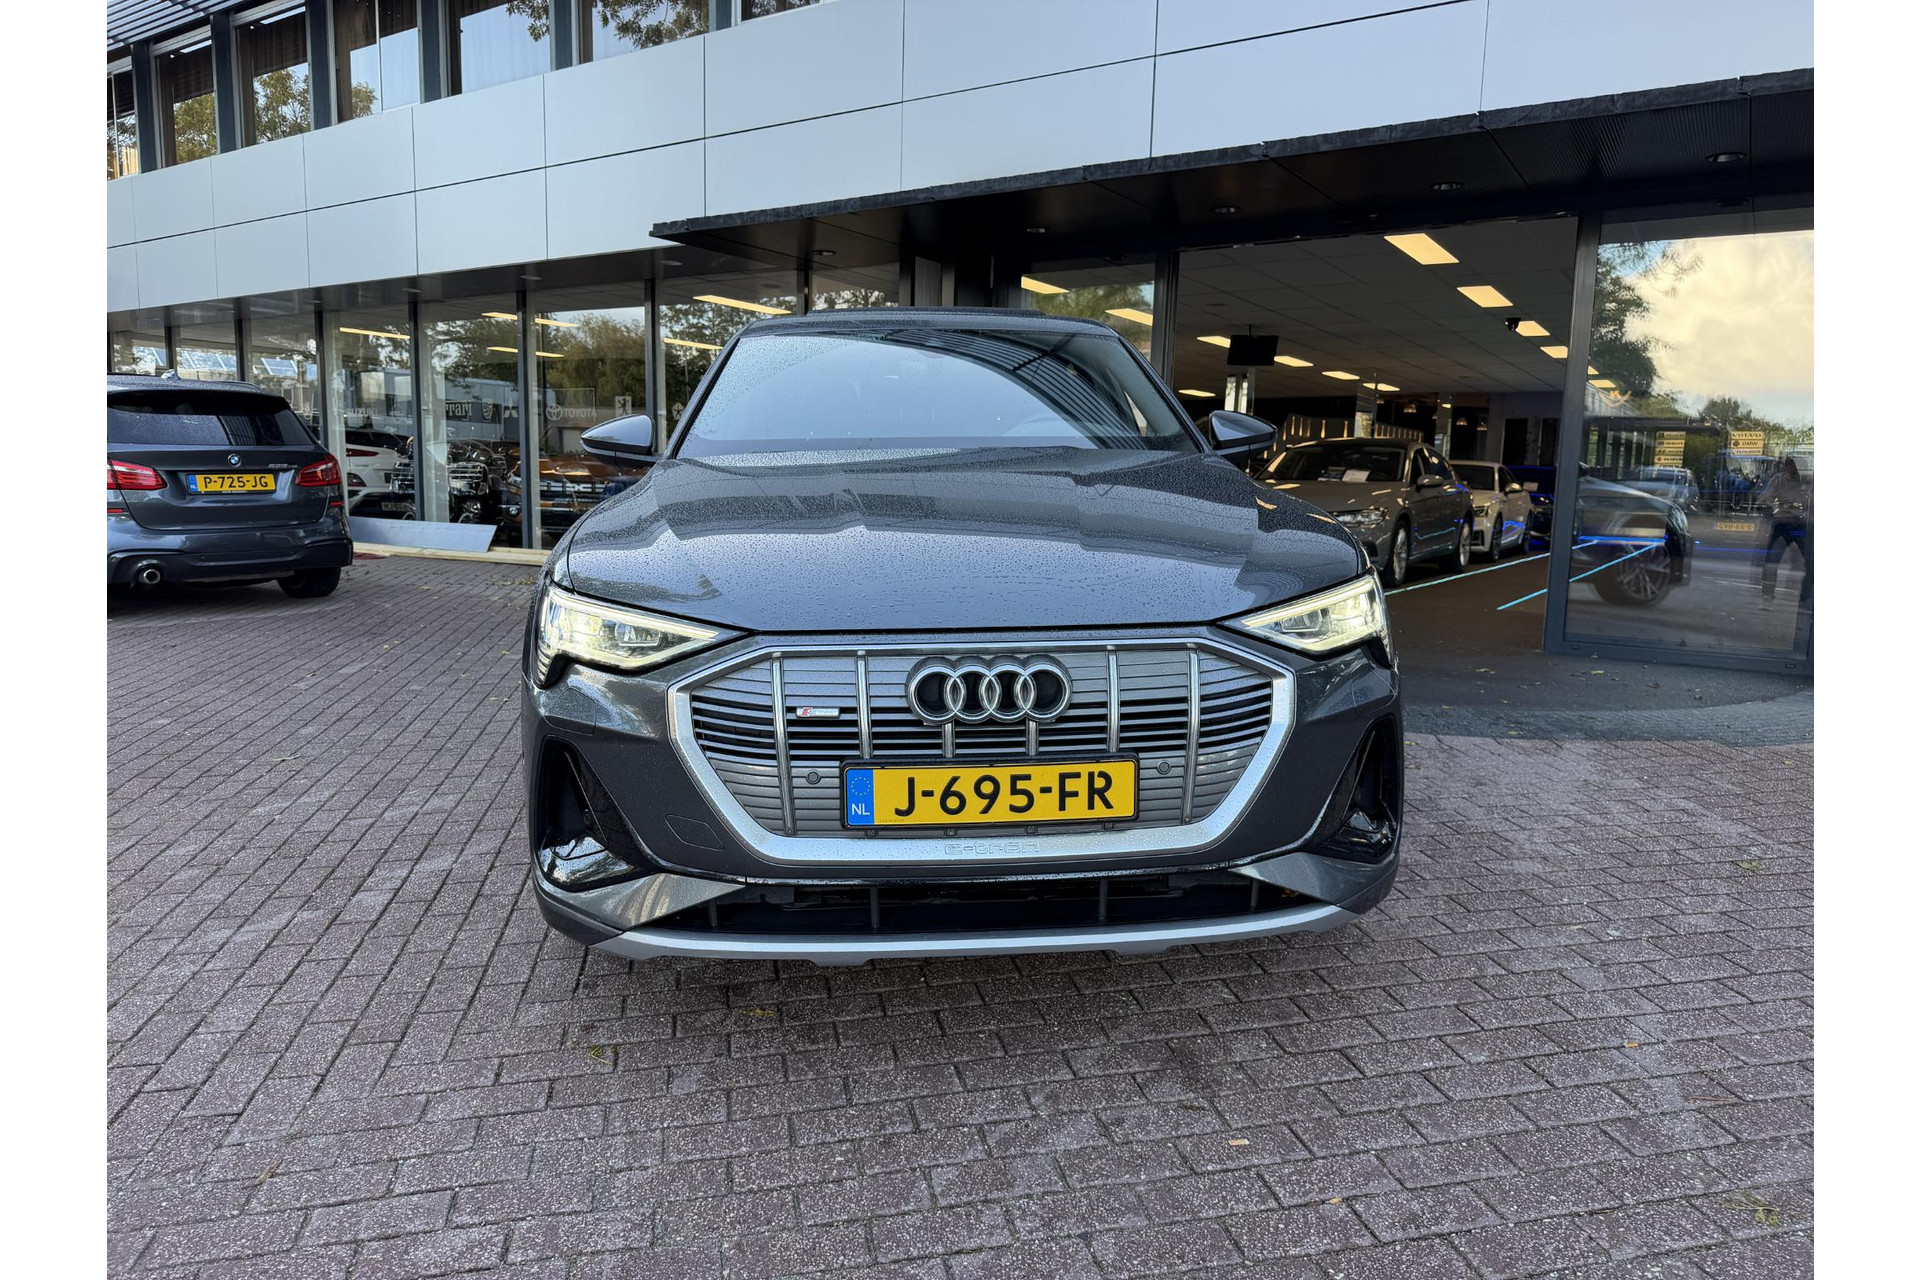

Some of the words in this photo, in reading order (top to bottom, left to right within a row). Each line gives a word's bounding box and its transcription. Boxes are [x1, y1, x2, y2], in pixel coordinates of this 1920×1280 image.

[444, 402, 472, 417] rrari
[563, 408, 597, 418] TOYOTA
[203, 476, 268, 488] P-725-JG
[895, 770, 1114, 817] J-695-FR
[851, 803, 871, 816] NL
[945, 841, 1040, 855] e-tron
